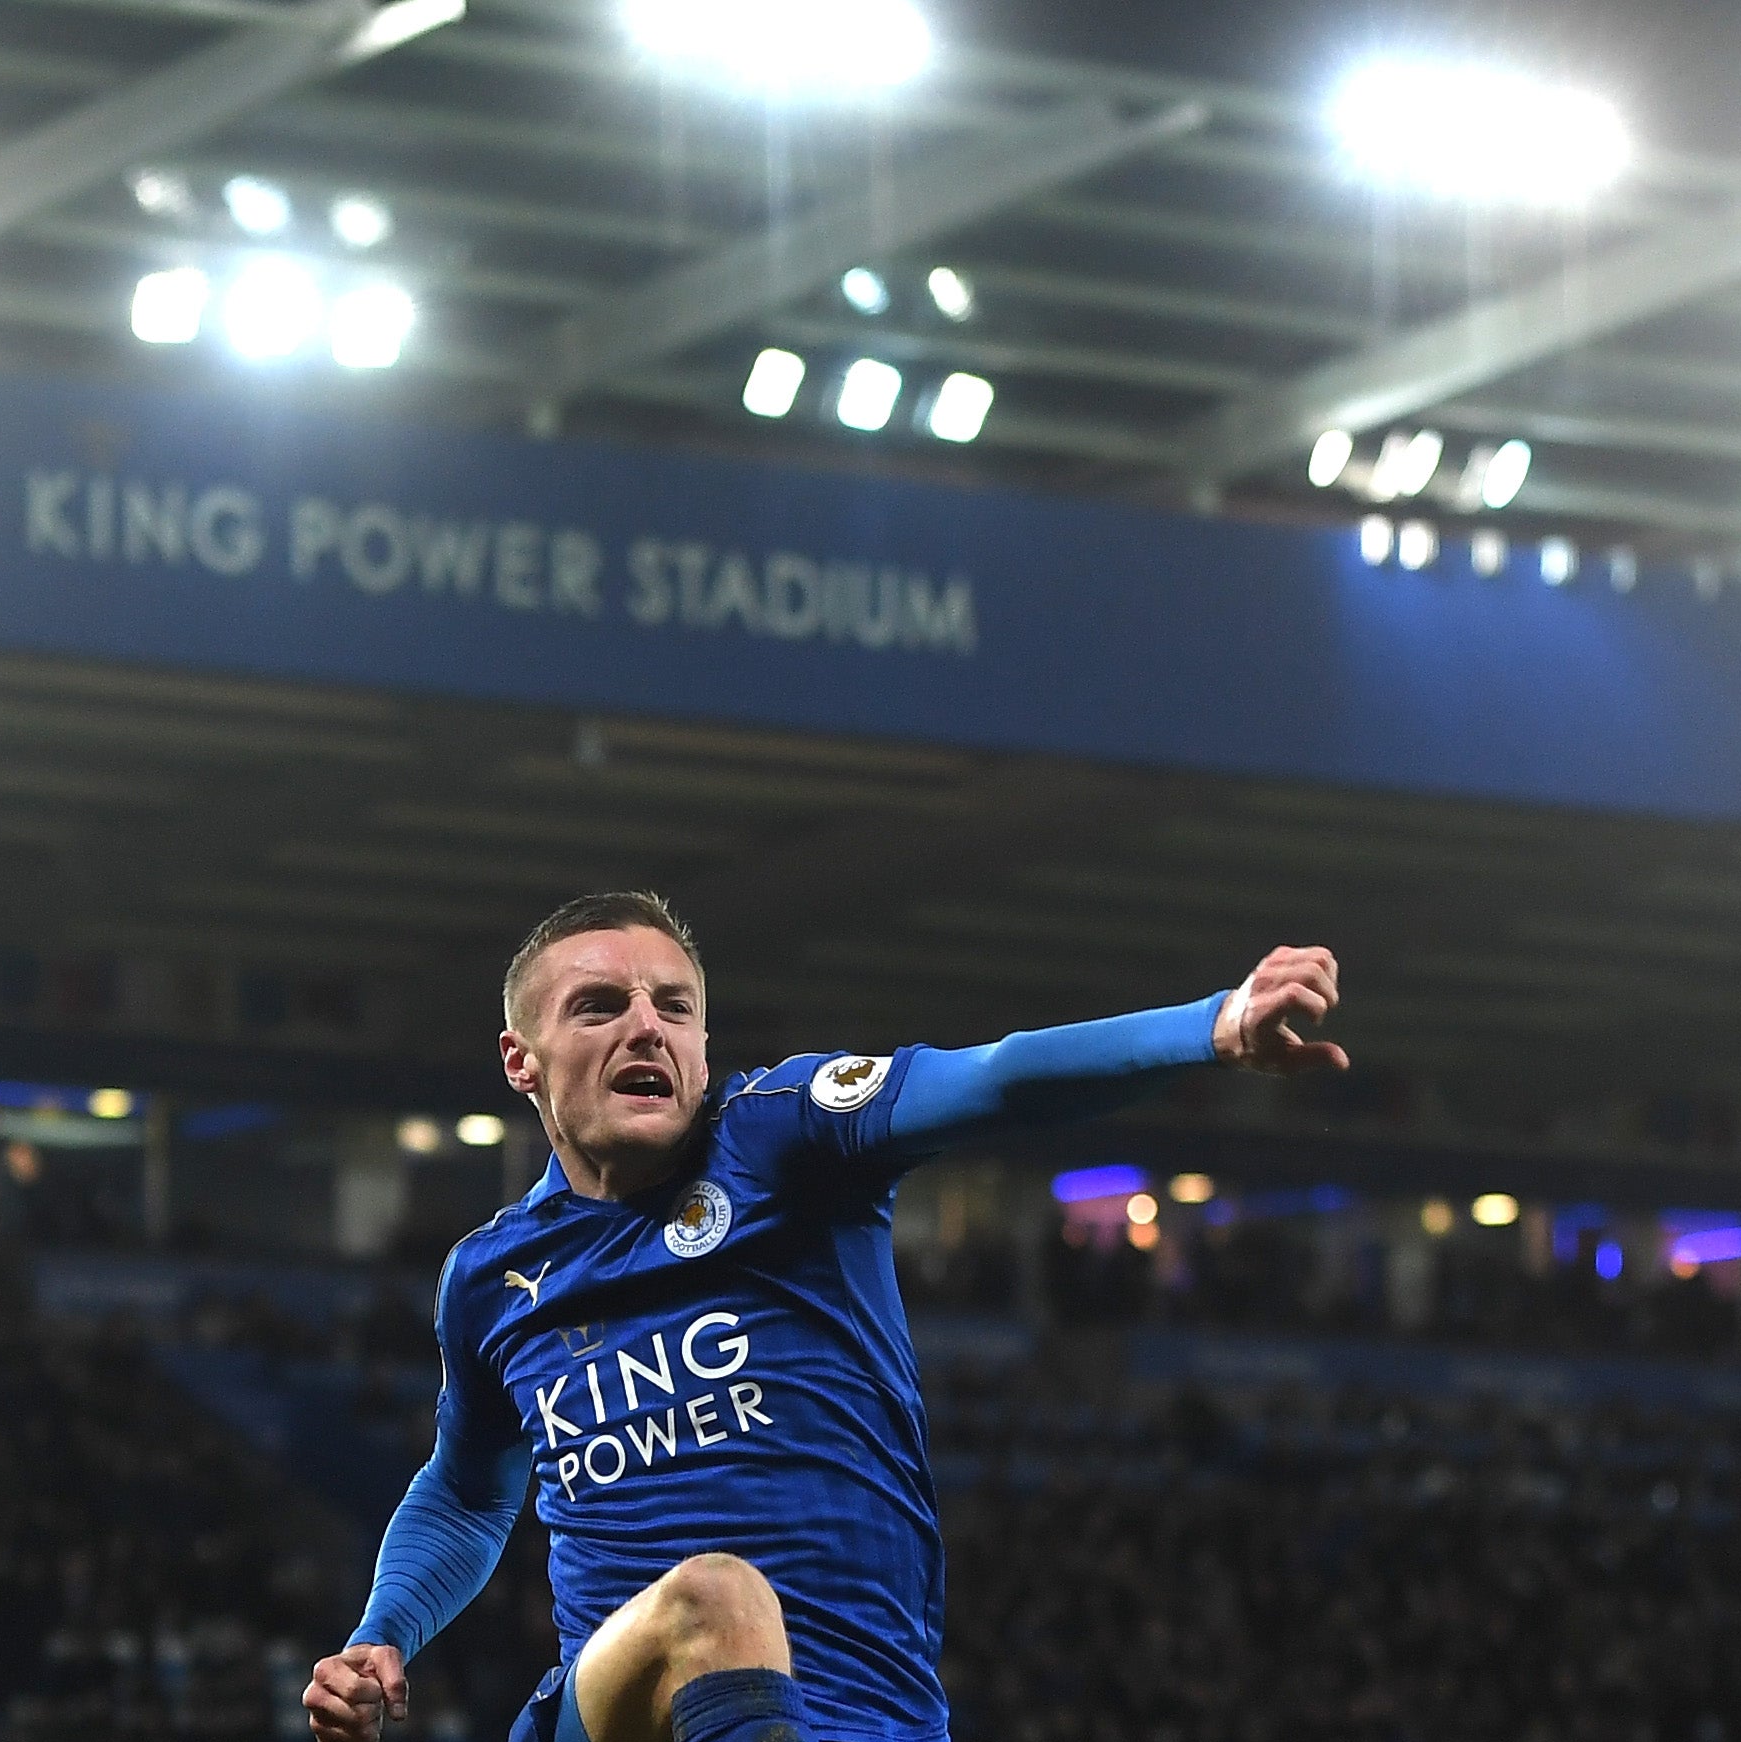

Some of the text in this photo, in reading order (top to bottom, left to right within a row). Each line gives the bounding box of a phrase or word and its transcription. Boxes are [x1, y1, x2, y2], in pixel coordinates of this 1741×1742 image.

[24, 470, 978, 655] KING POWER STADIUM
[669, 1204, 727, 1252] FOOTBALL CLUB
[535, 1312, 749, 1450] KING
[558, 1381, 774, 1503] POWER
